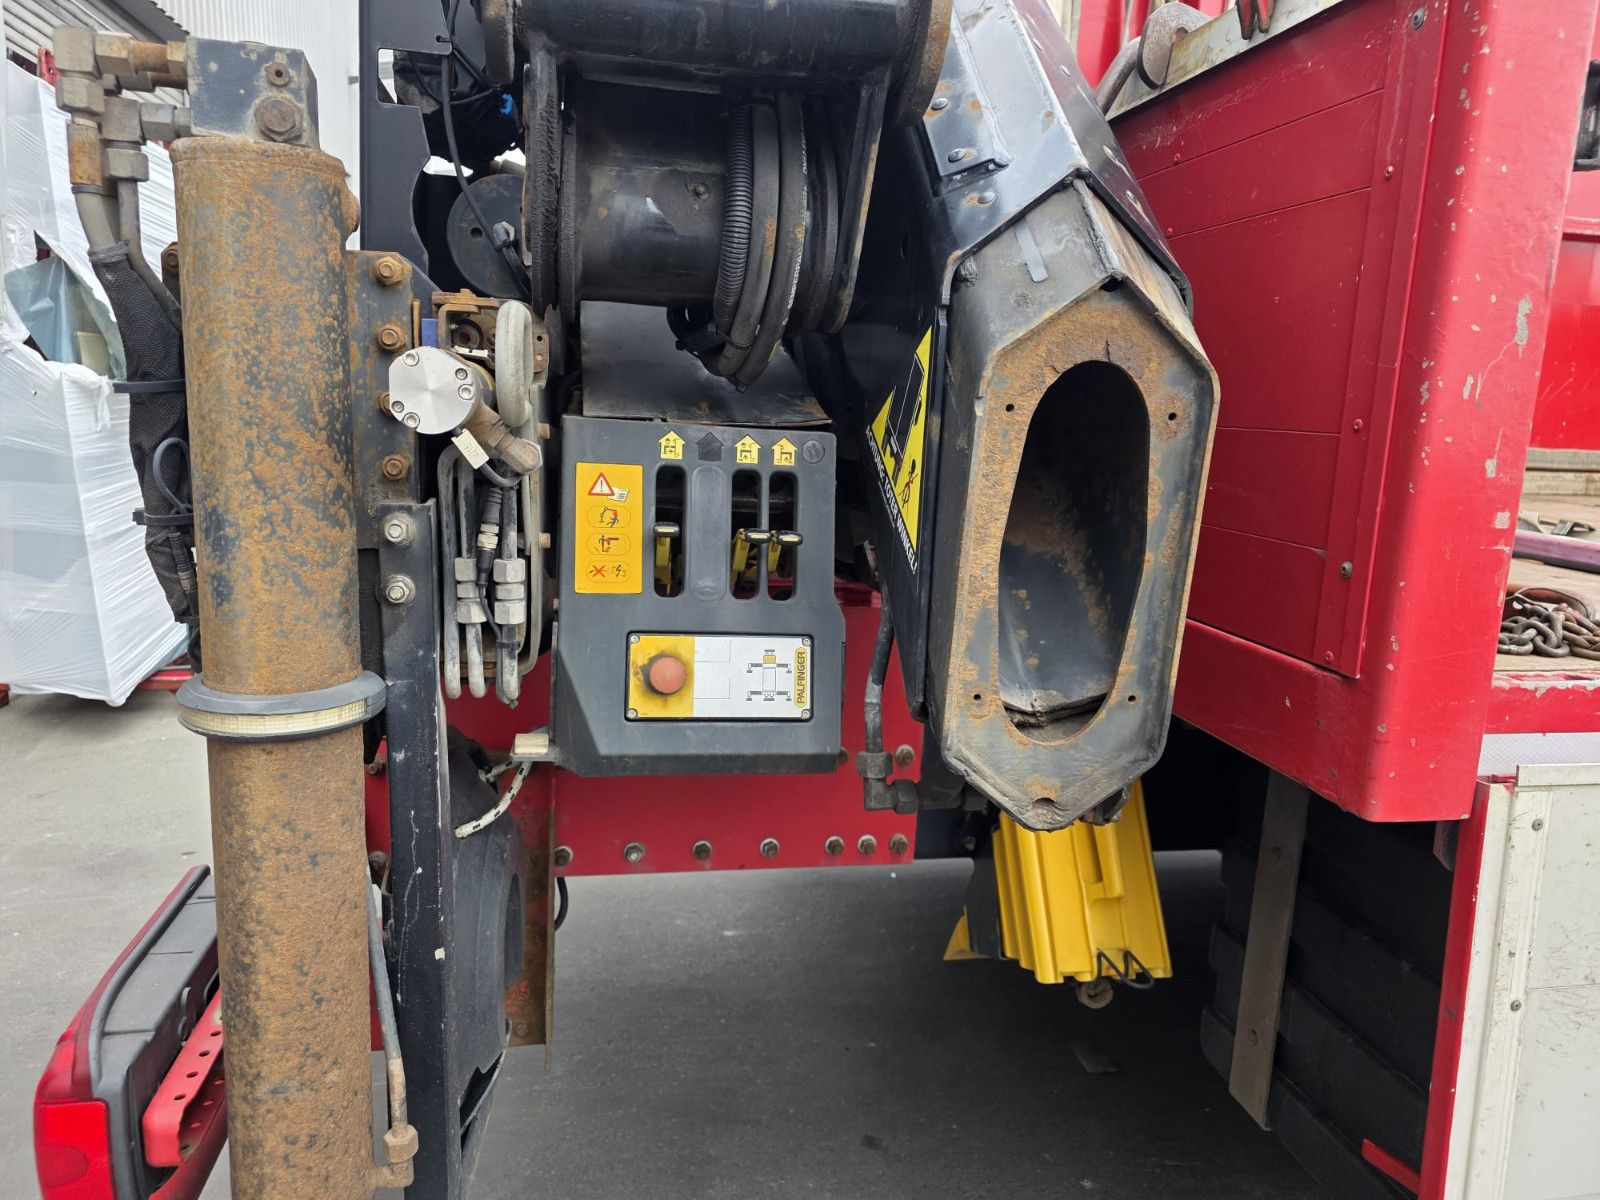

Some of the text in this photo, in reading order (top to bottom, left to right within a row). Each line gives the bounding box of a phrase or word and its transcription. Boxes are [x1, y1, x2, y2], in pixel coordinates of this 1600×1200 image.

[885, 476, 898, 519] TOTER
[897, 513, 918, 575] WINKEL!
[797, 651, 805, 704] PALFINGER
